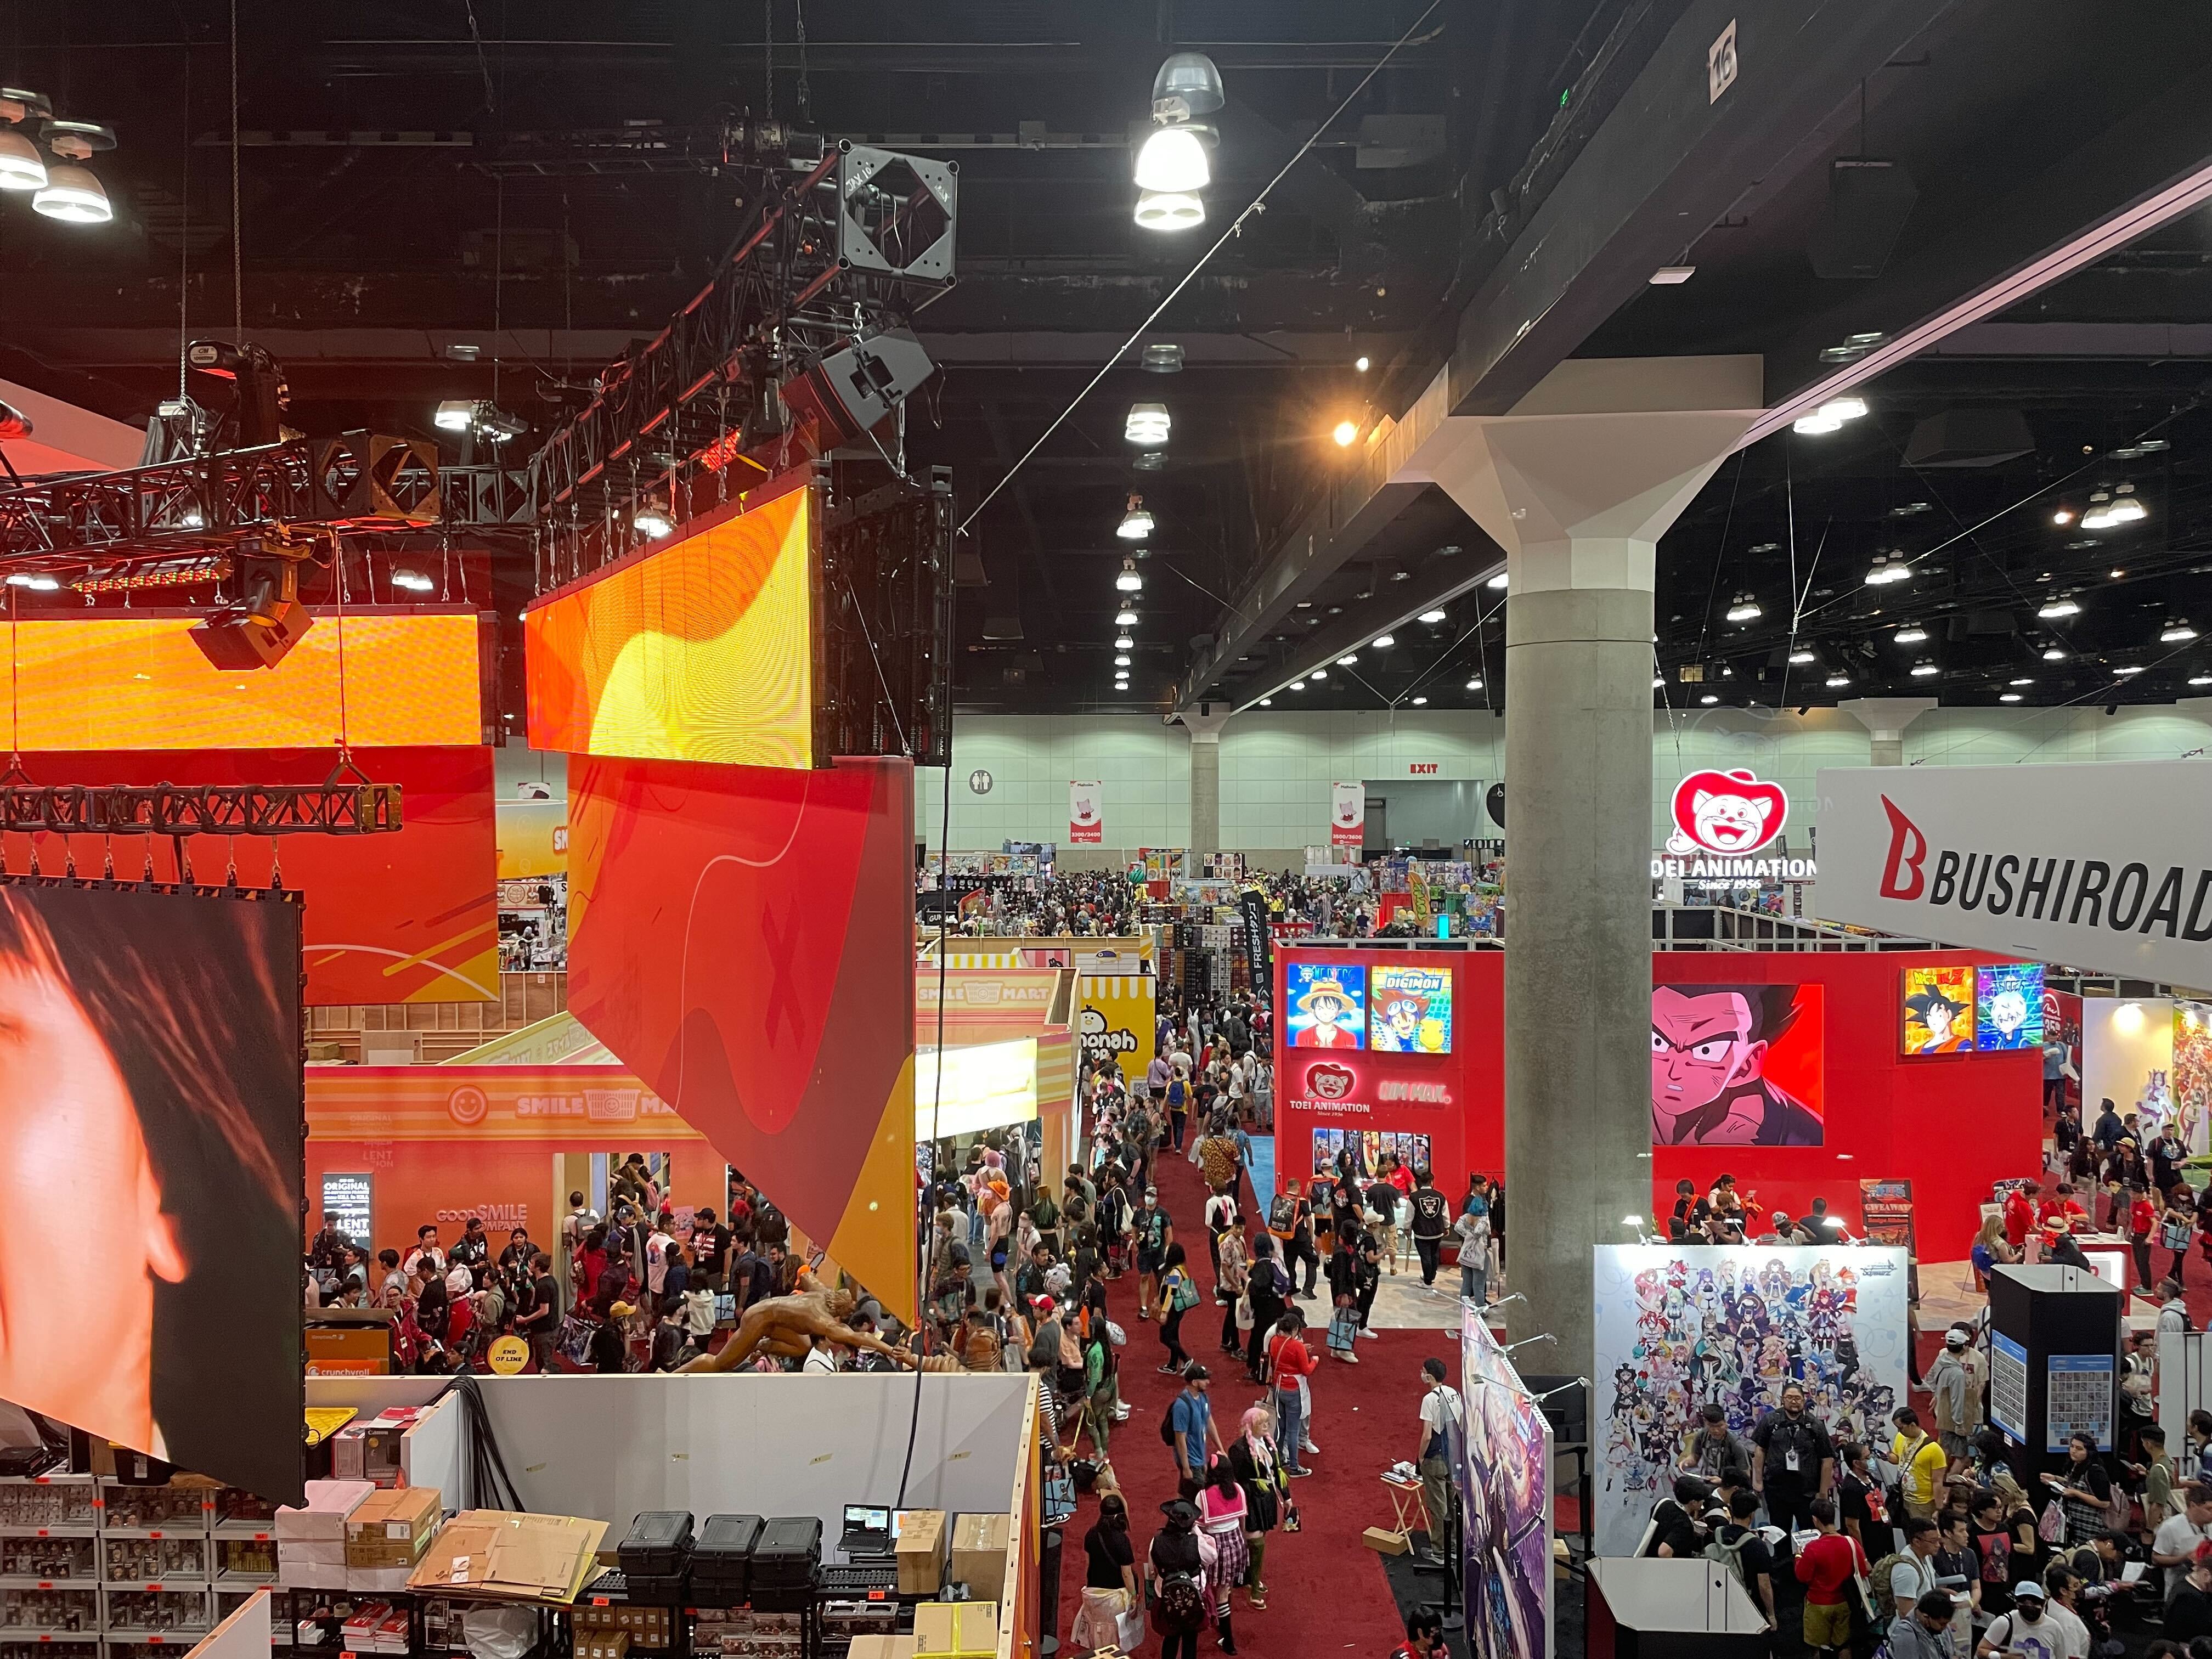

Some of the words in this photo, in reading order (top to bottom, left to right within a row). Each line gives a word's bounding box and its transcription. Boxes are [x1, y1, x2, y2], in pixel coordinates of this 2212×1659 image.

[1713, 35, 1732, 89] 16
[1410, 764, 1438, 774] EXIT
[1651, 859, 1685, 878] OEI
[1691, 859, 1817, 877] ANIMATION
[1698, 879, 1730, 890] Since
[1733, 879, 1762, 890] 1956
[1929, 850, 2212, 941] BUSHIROAD
[1386, 977, 1440, 989] DIGIMON
[919, 988, 964, 1000] SMILE
[1003, 988, 1048, 1000] MART
[518, 1097, 584, 1114] SMILE
[641, 1097, 676, 1114] MA
[1290, 1101, 1312, 1110] TOEI
[1313, 1102, 1370, 1113] ANIMATION
[324, 1182, 370, 1190] ORIGINAL
[477, 1204, 527, 1221] SMILE
[479, 1220, 527, 1232] OMPANY
